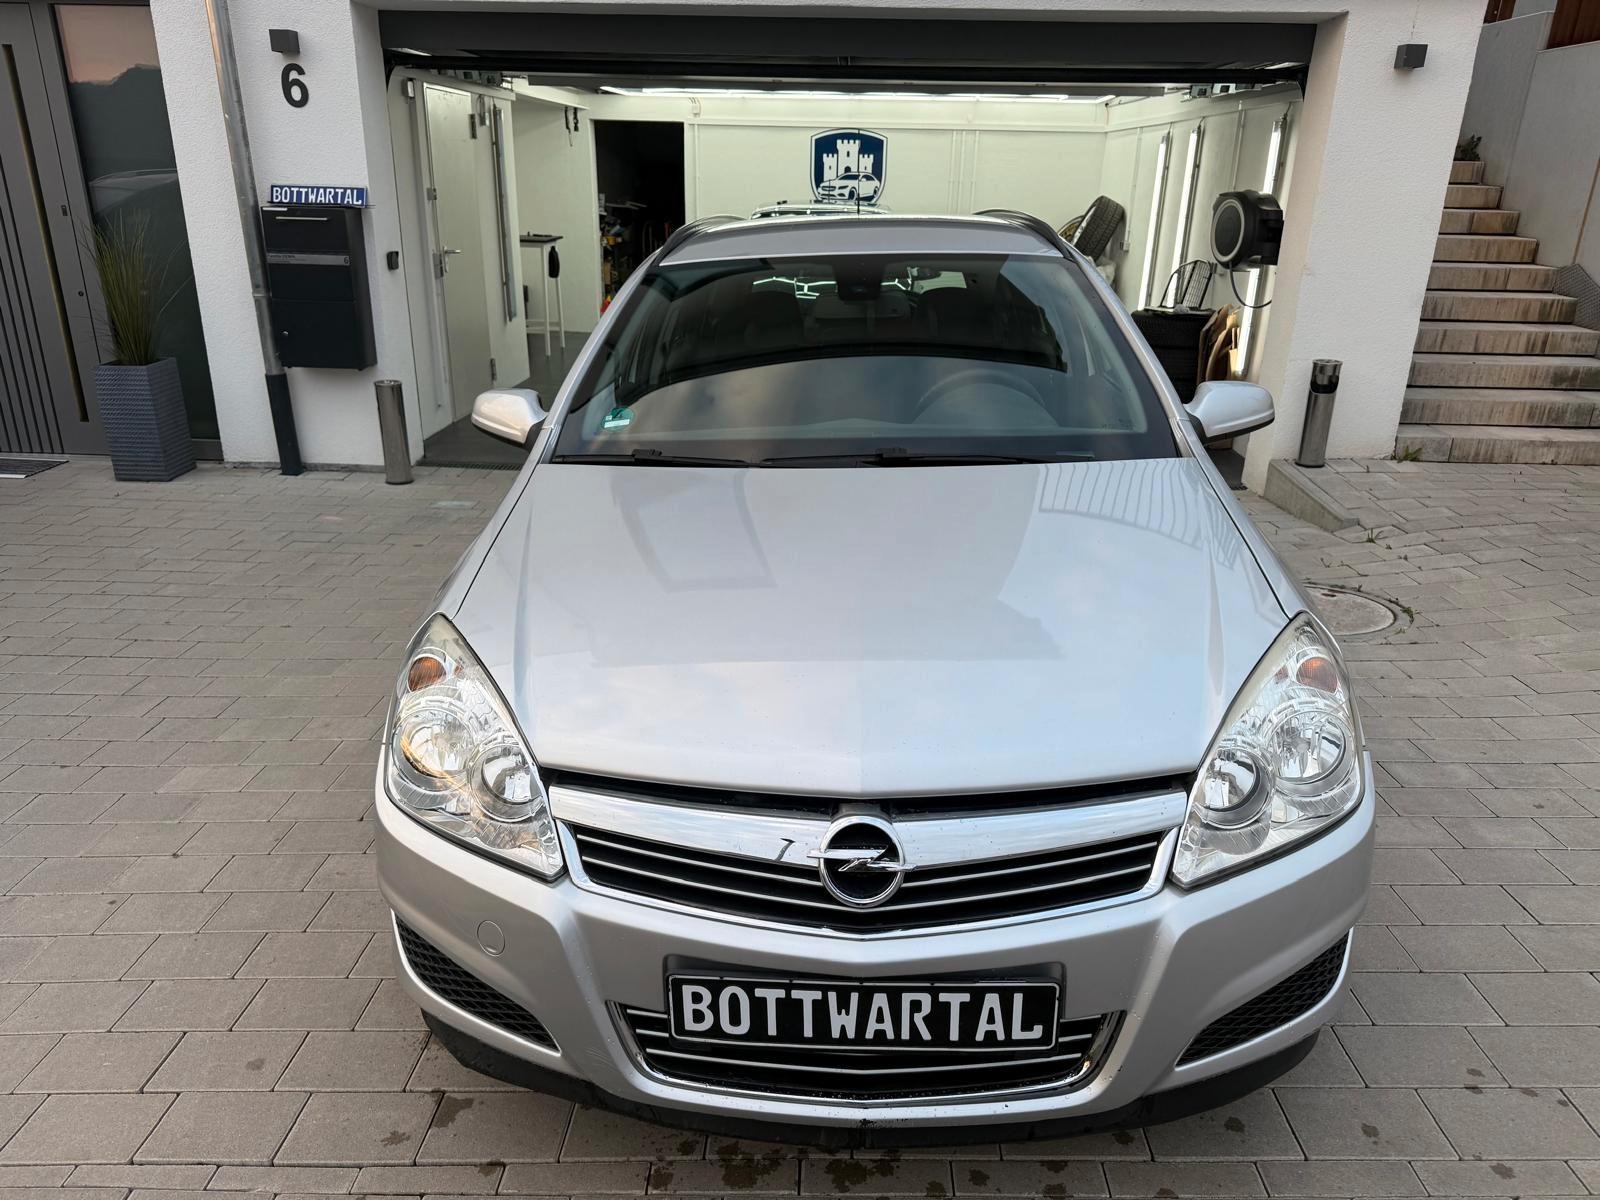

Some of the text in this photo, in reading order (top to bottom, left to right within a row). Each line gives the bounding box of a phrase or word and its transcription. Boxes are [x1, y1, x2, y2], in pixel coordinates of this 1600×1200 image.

[281, 63, 309, 108] 6
[272, 187, 362, 205] BOTTWARTAL
[681, 984, 1043, 1041] BOTTWARTAL
